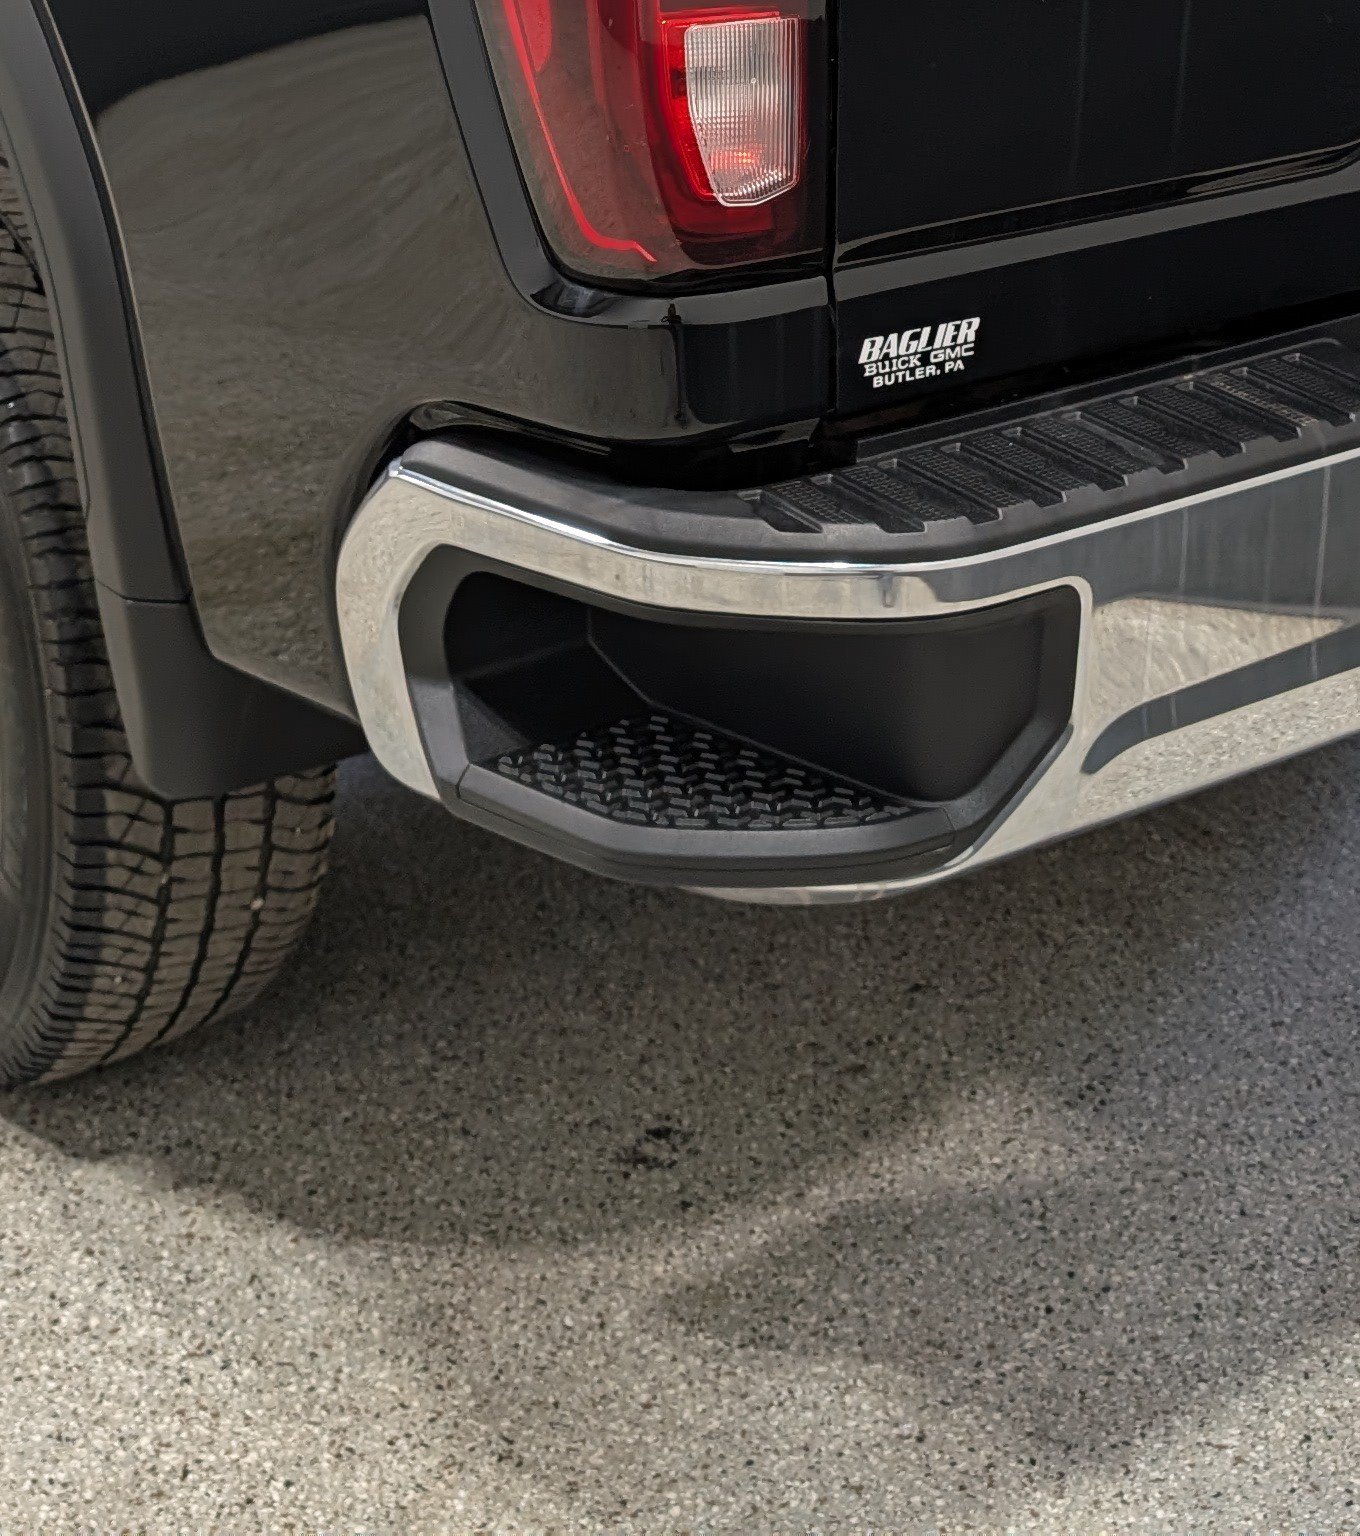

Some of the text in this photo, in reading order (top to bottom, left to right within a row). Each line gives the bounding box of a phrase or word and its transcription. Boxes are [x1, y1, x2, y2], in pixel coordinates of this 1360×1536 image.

[858, 316, 980, 364] BAGLIER
[863, 343, 975, 377] BUICK GMC
[944, 359, 965, 374] PA
